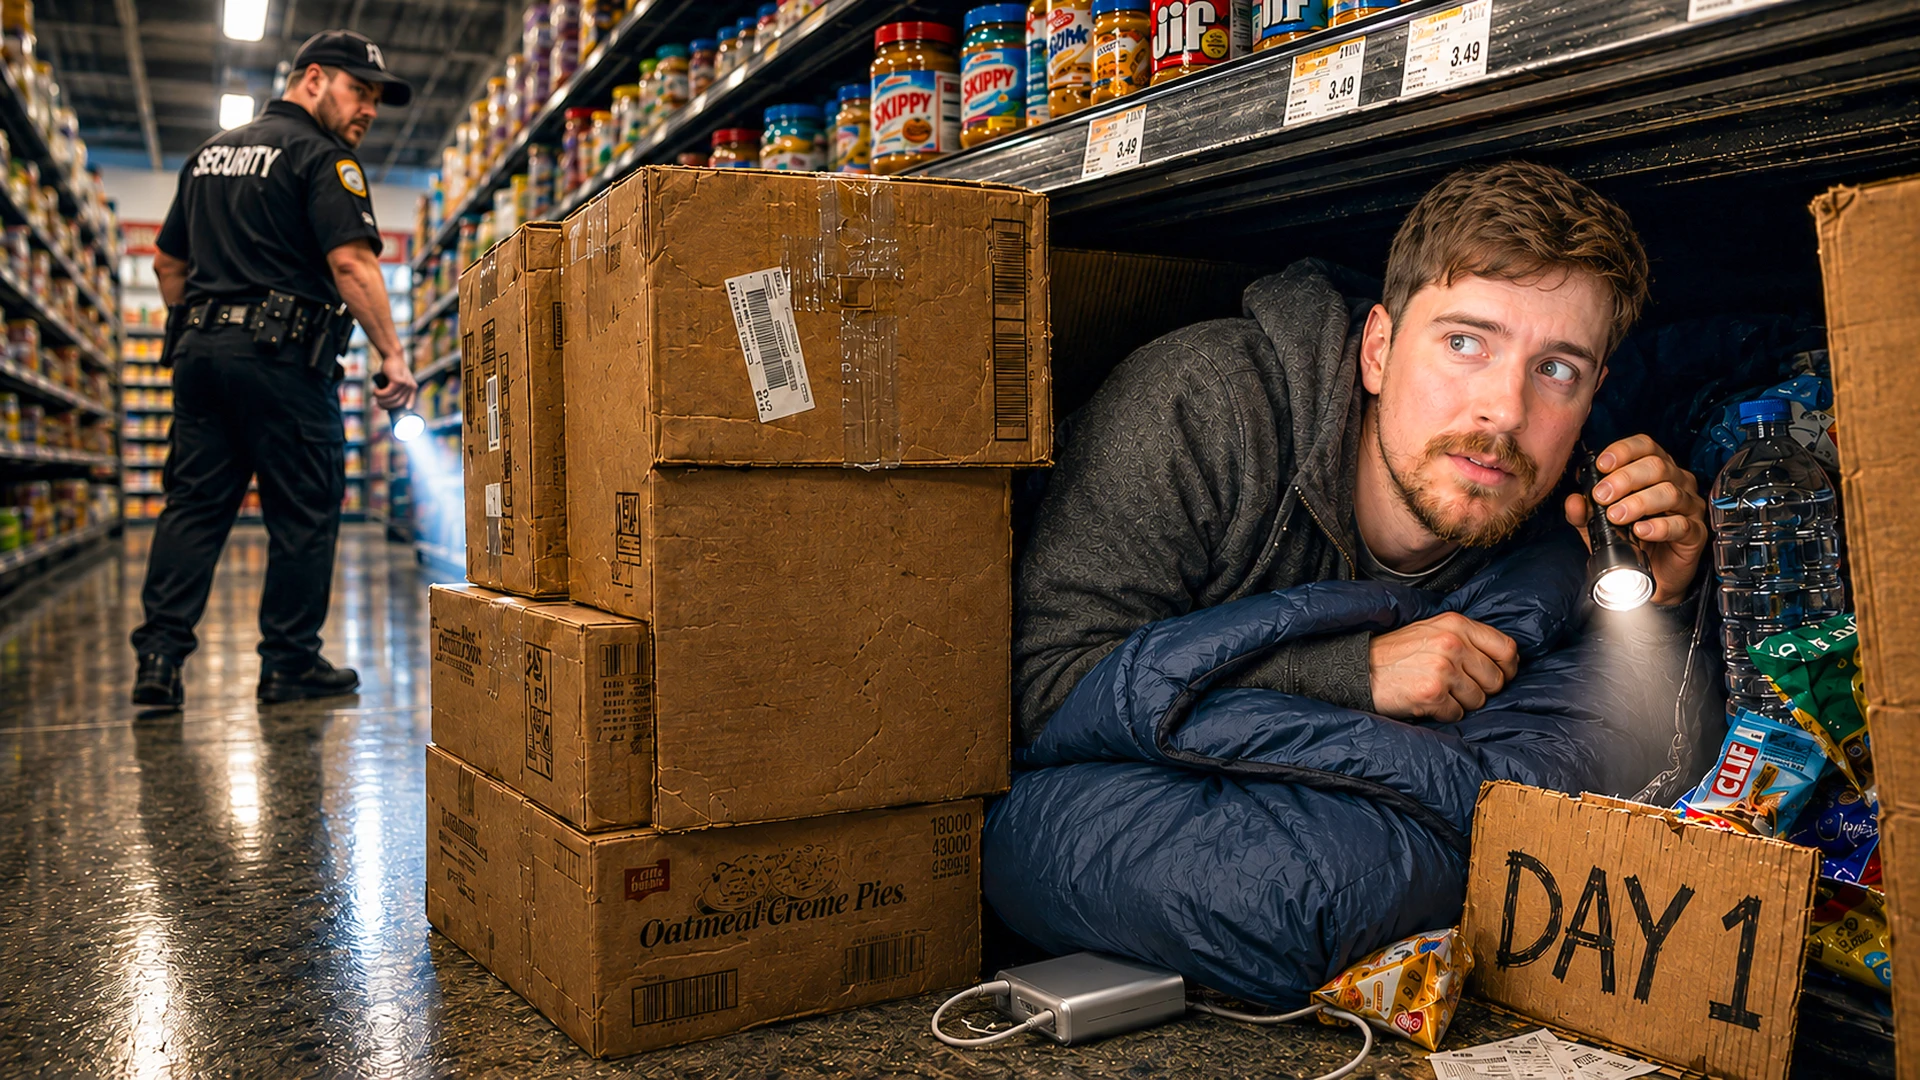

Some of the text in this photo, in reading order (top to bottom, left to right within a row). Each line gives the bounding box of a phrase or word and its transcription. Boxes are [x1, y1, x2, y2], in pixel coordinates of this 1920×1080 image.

[1152, 1, 1216, 60] jif
[1451, 41, 1480, 67] 3.49
[964, 68, 1016, 104] SKIPPY
[1329, 76, 1354, 100] 3.49
[875, 92, 933, 131] SKIPPY
[192, 145, 282, 178] SECURITY
[1117, 137, 1138, 158] 3.49
[1716, 744, 1758, 795] CLIF
[930, 812, 972, 837] 18000
[932, 832, 972, 857] 43000
[639, 900, 760, 948] Oatmeal
[767, 892, 849, 926] Creme
[1495, 849, 1763, 1032] DAY 1
